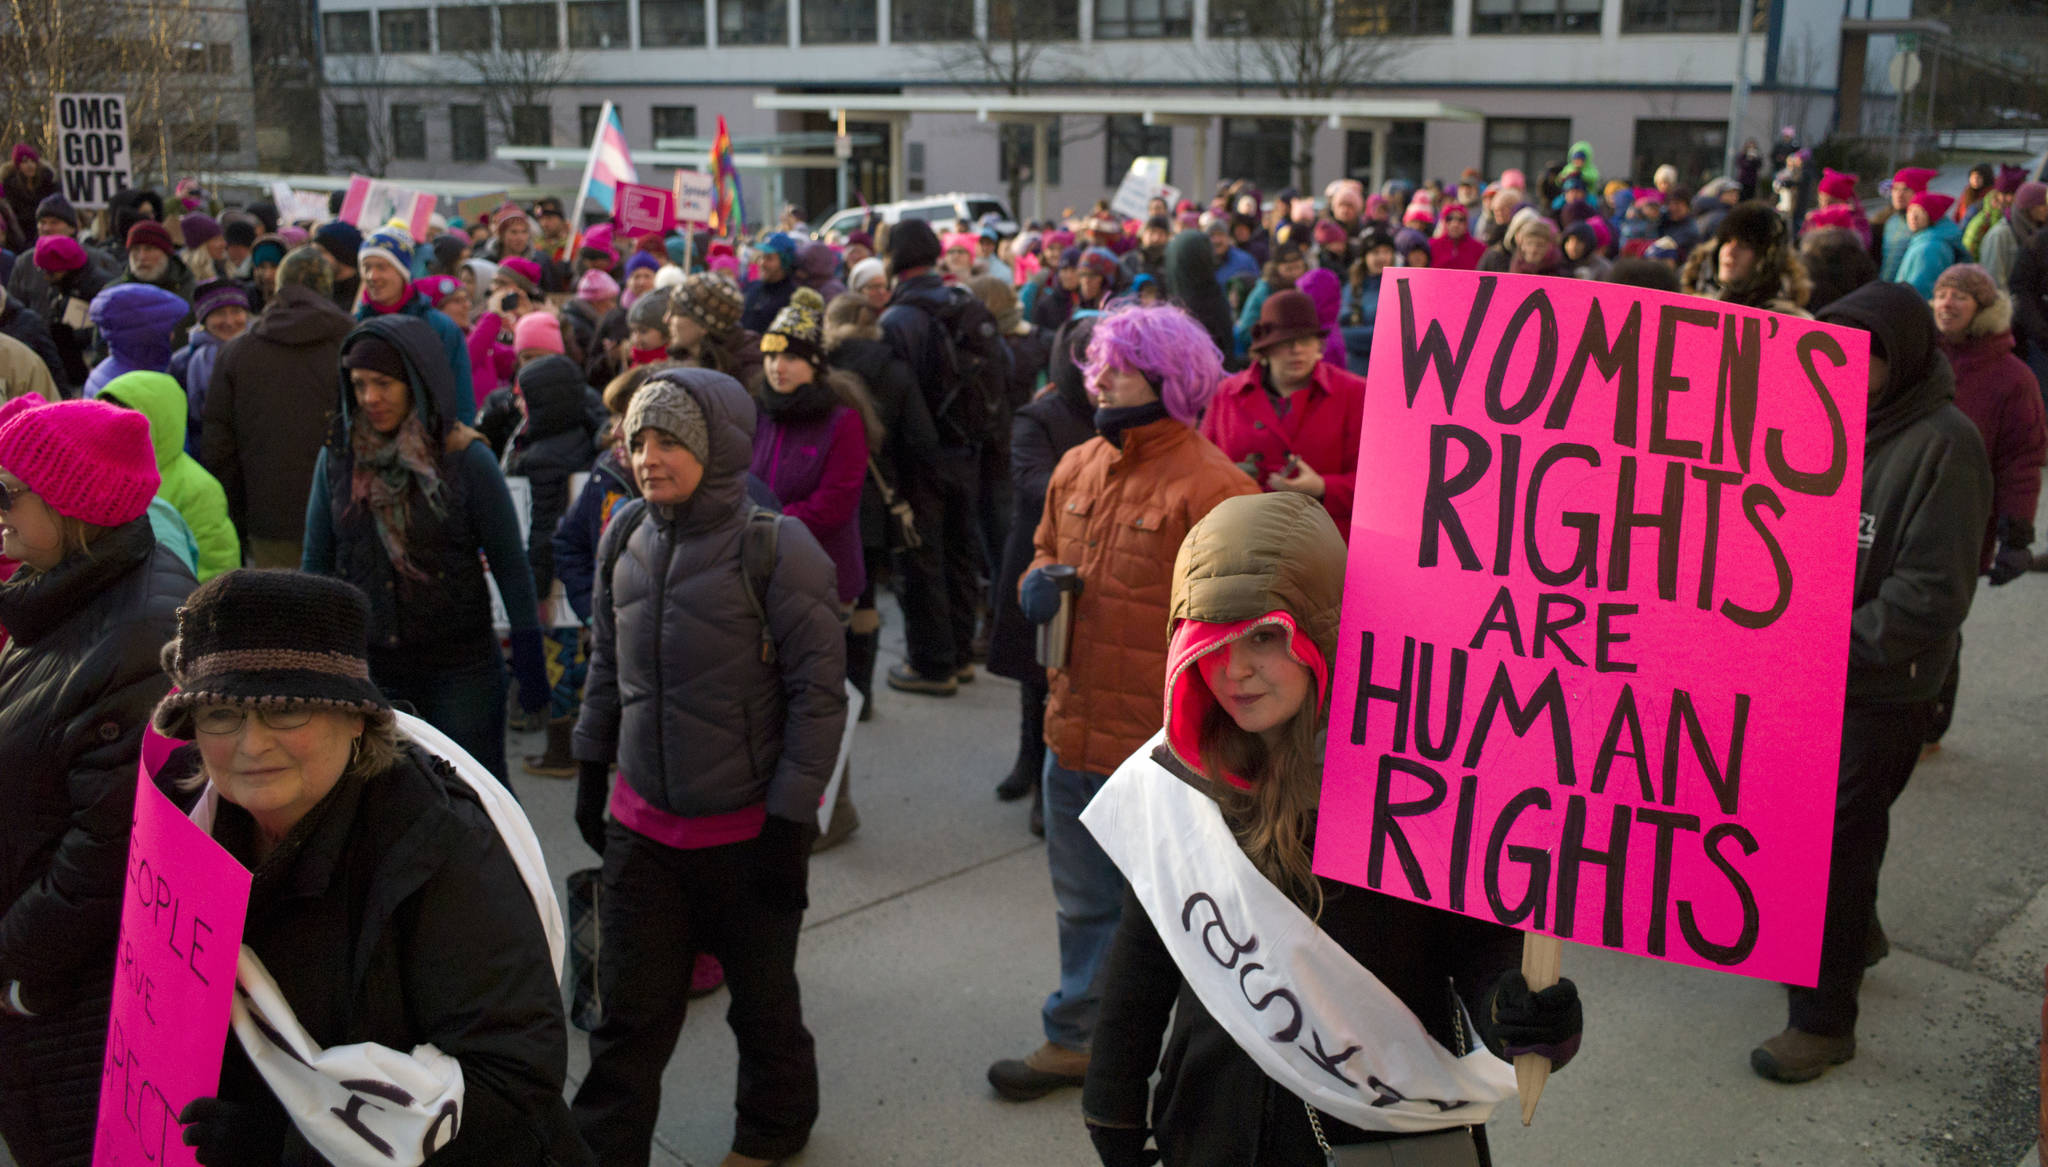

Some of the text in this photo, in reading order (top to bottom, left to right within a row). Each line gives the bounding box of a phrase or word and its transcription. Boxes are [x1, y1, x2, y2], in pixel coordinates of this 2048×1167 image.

[60, 97, 122, 130] OMG
[64, 132, 123, 167] GOP
[1397, 275, 1848, 497] WOMEN'S
[1418, 424, 1794, 630] RIGHTS
[1469, 586, 1639, 673] ARE
[1350, 631, 1751, 815] HUMAN
[1367, 754, 1760, 966] RIGHTS
